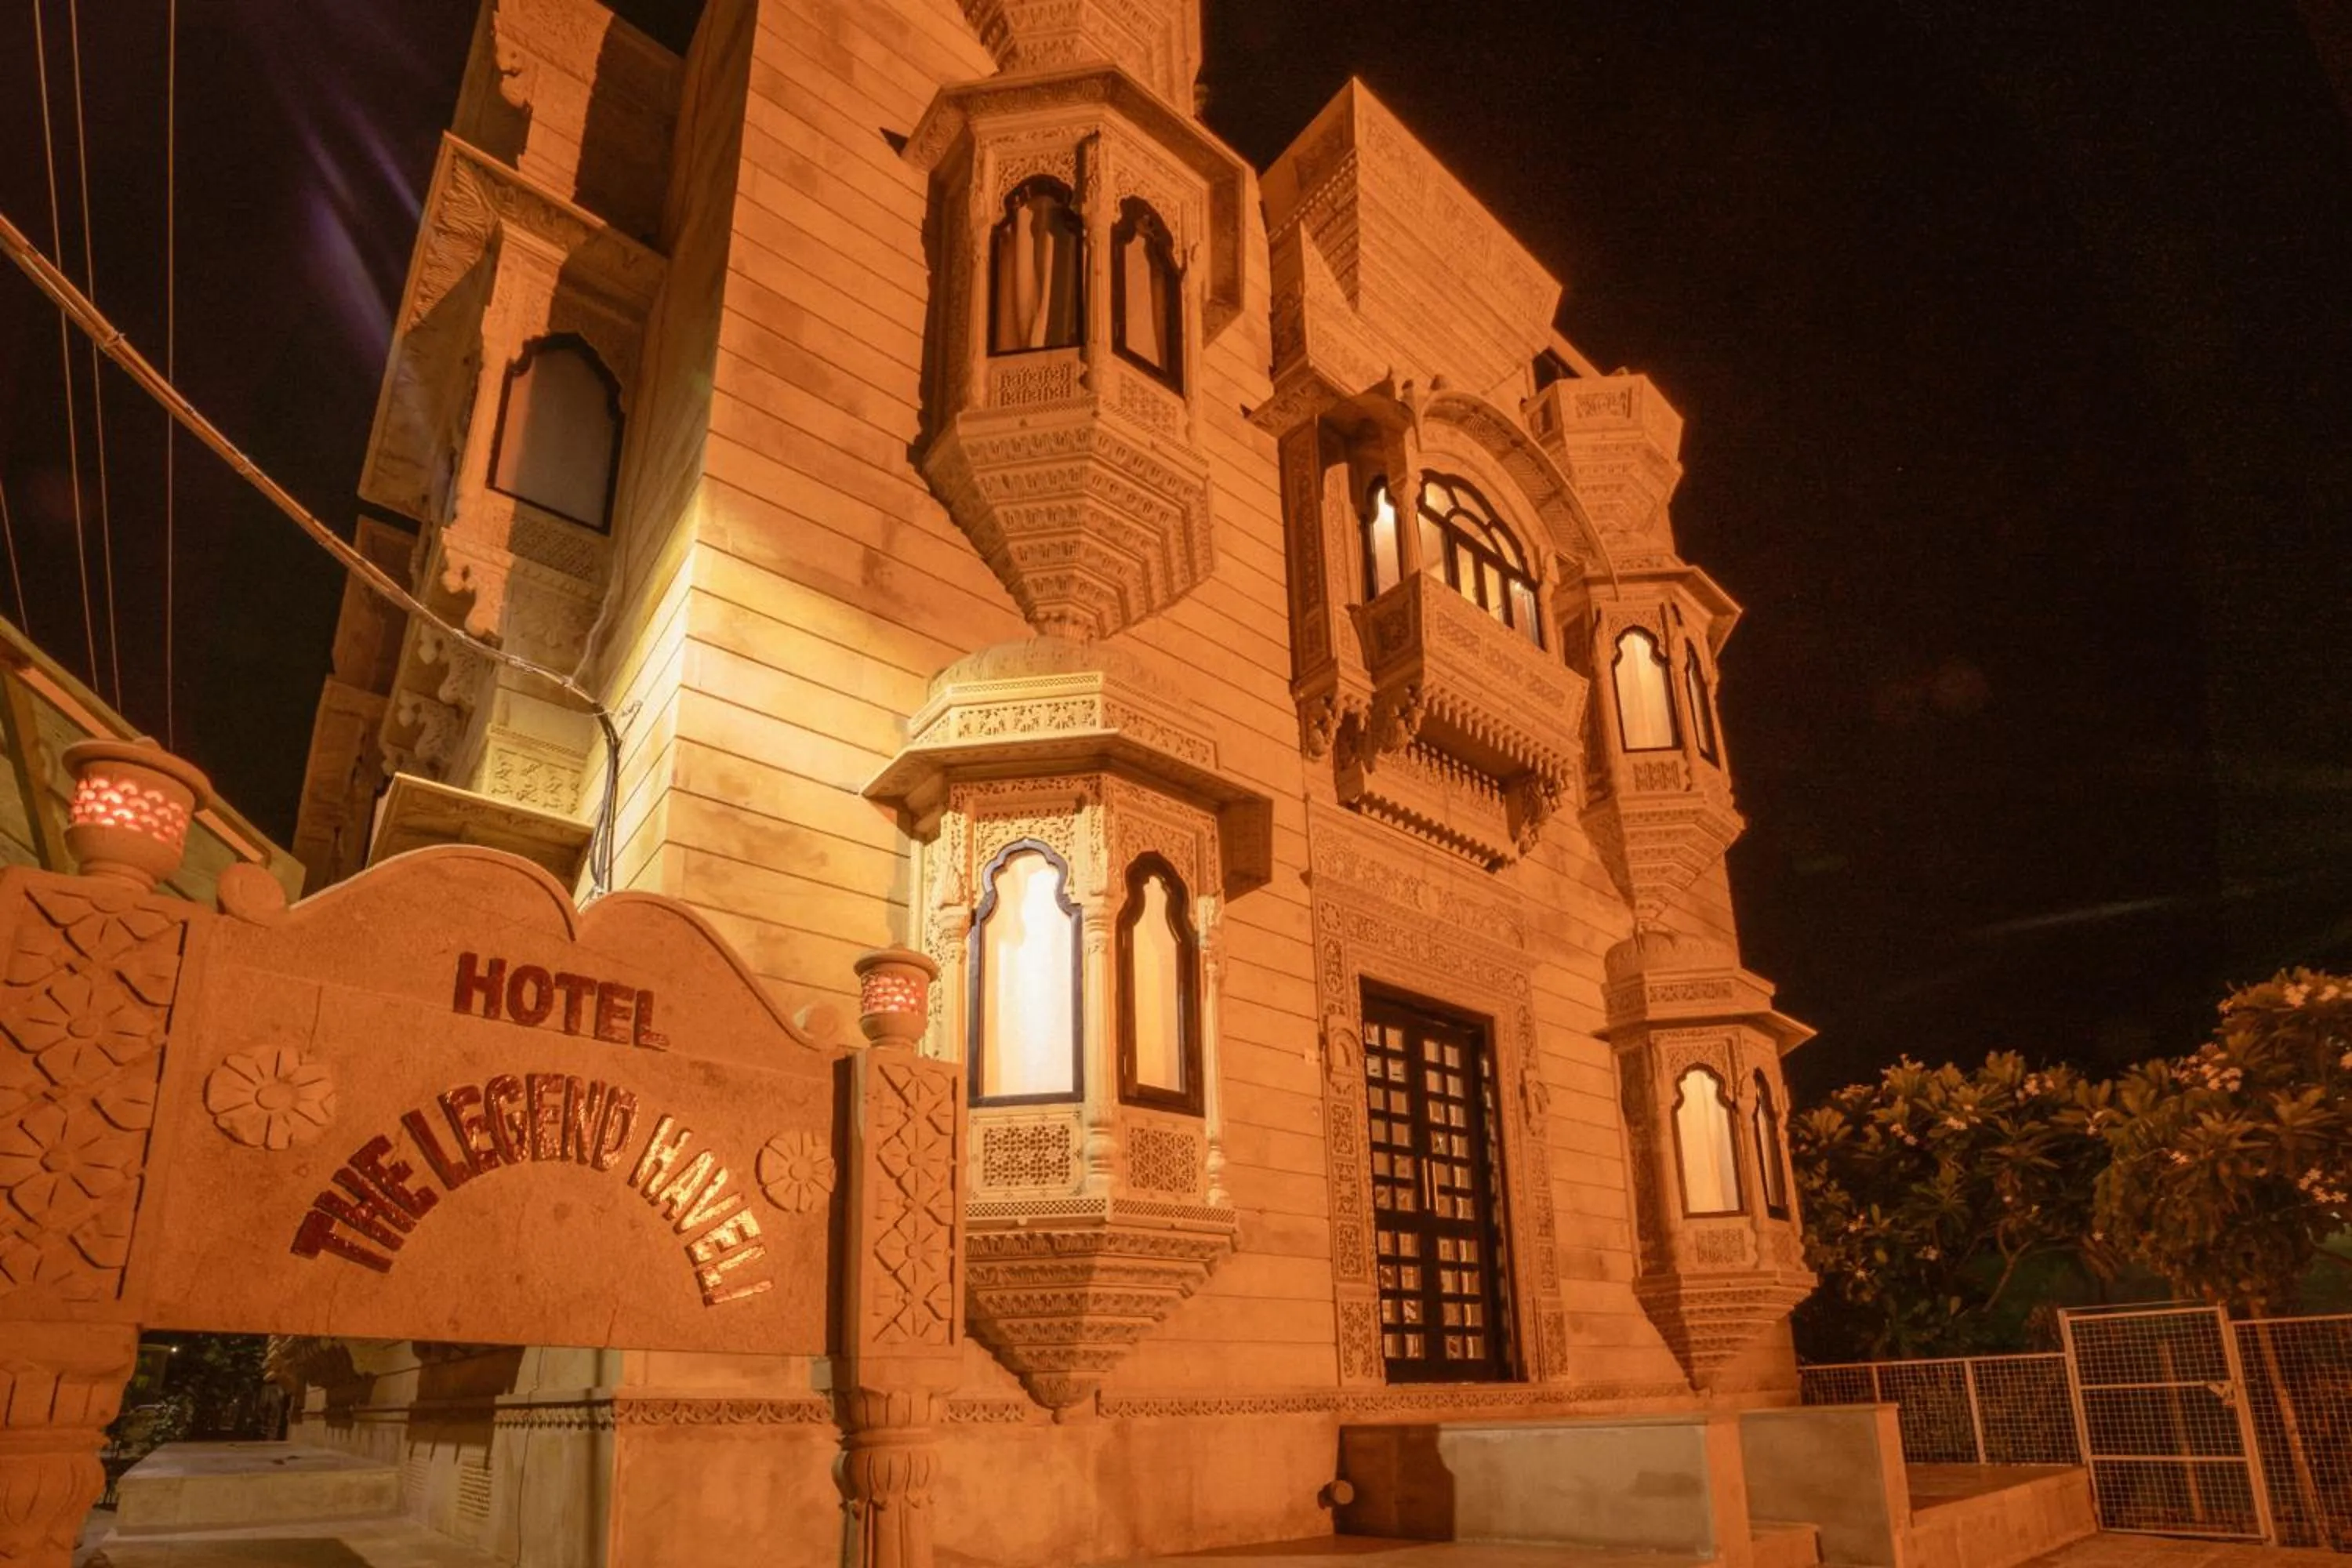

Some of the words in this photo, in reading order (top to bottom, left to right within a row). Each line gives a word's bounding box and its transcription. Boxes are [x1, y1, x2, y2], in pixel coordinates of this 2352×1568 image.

[452, 951, 670, 1052] HOTEL
[289, 1134, 439, 1274] THE
[401, 1072, 640, 1192] LEGEND
[627, 1113, 774, 1307] HAVELI
